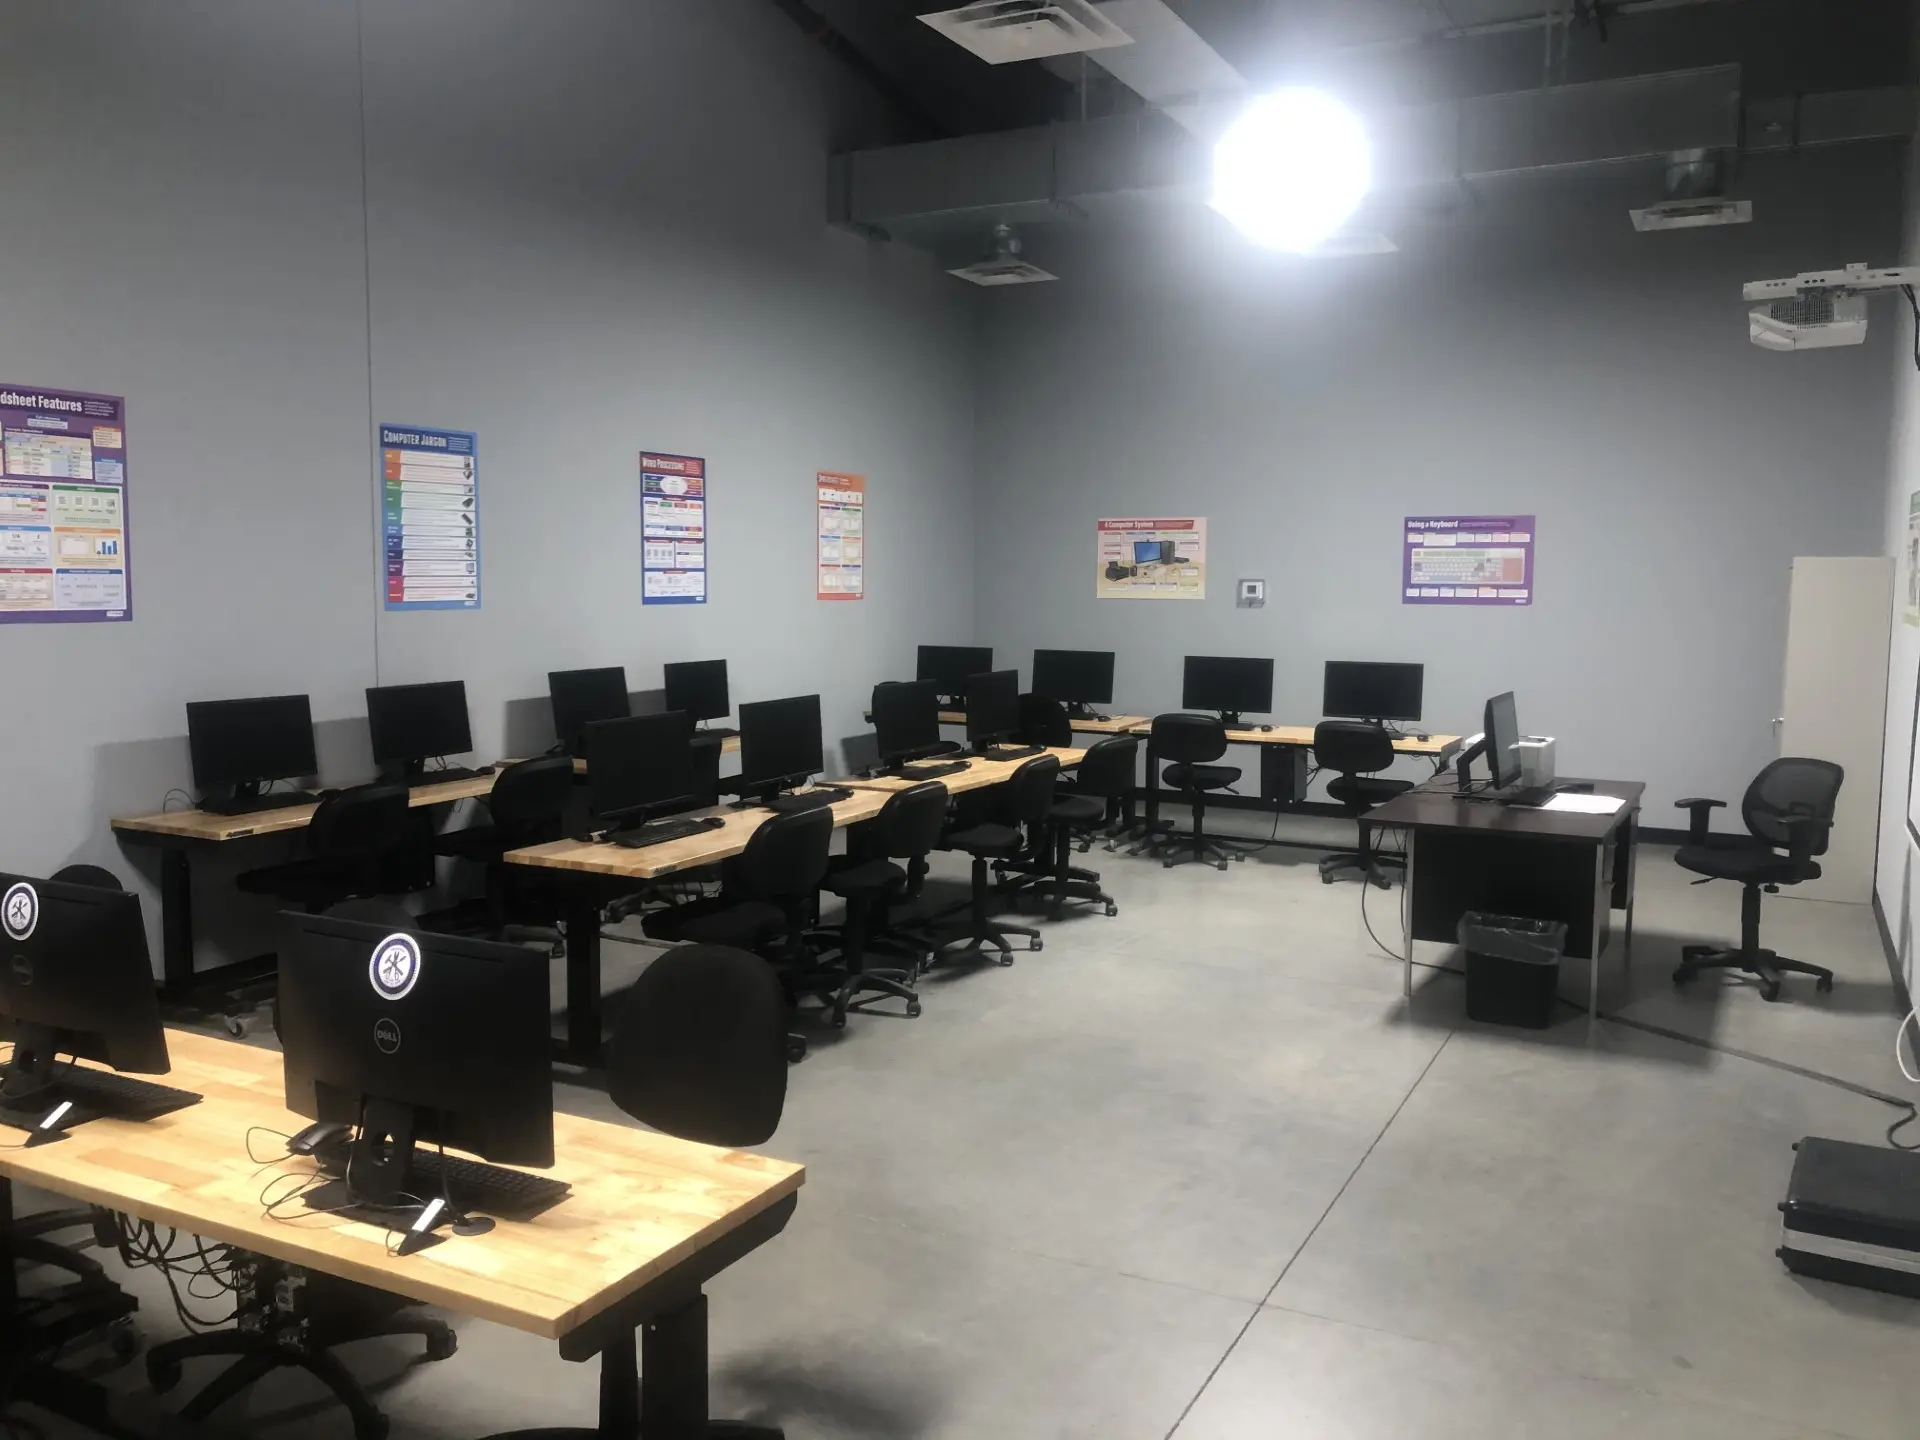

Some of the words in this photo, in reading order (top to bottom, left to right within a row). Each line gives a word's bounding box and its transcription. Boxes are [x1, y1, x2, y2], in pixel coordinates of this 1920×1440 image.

[38, 395, 82, 412] Features
[1109, 521, 1133, 530] Computer
[1134, 520, 1154, 530] System
[1430, 520, 1459, 530] Keyboard
[377, 1030, 397, 1042] DELL
